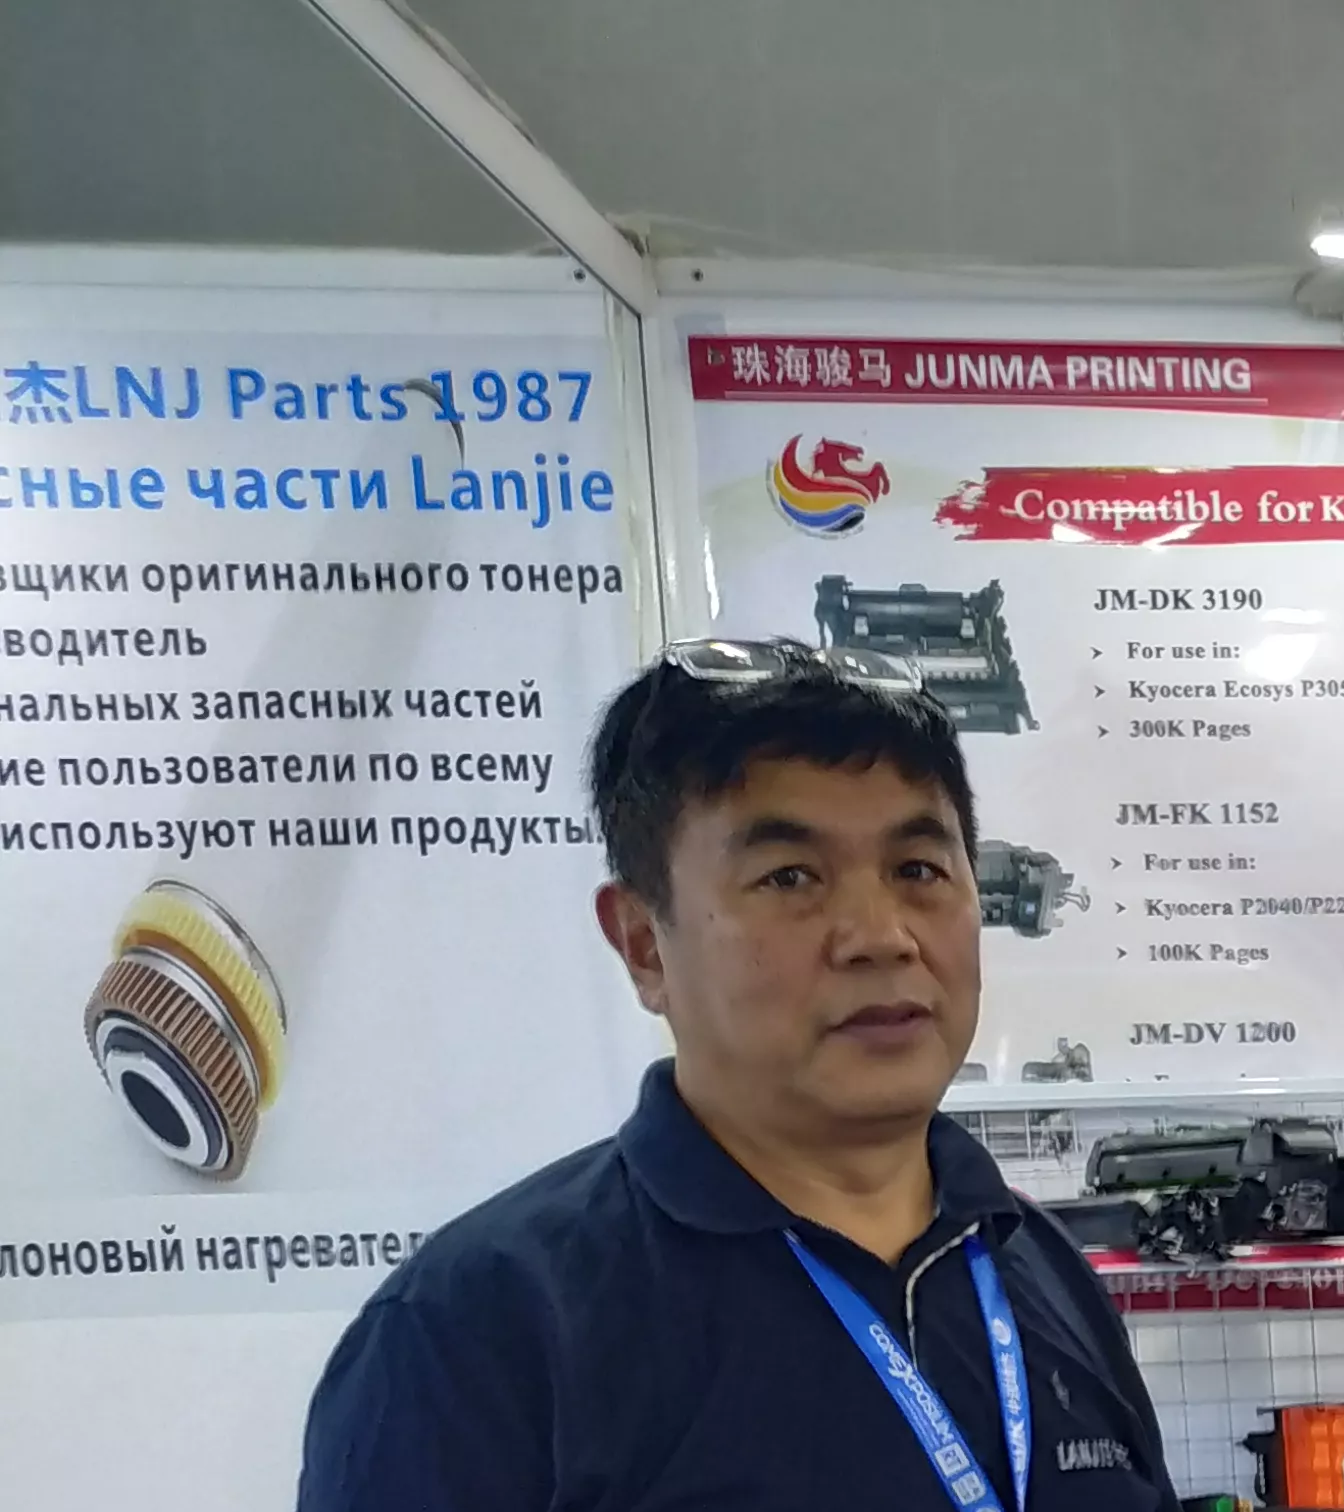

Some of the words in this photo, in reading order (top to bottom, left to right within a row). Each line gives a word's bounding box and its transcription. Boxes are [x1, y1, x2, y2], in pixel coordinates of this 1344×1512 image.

[732, 345, 891, 388] 珠海骏马
[905, 355, 1053, 391] JUNMA
[1067, 357, 1251, 392] PRINTING
[2, 361, 199, 424] 杰LNJ
[227, 369, 409, 422] Parts
[431, 370, 593, 422] 1987
[188, 467, 388, 511] части
[411, 454, 616, 530] Lanjie
[1012, 489, 1244, 531] Compatible
[1257, 492, 1314, 525] for
[142, 561, 470, 602] оригинального
[479, 561, 625, 604] тонера
[1094, 589, 1193, 611] JM-DK
[1202, 589, 1263, 610] 3190
[3, 627, 208, 667] водитель
[1127, 642, 1165, 660] For
[1172, 646, 1206, 660] use
[1212, 642, 1240, 660] in:
[192, 690, 393, 720] запасных
[405, 680, 543, 719] частей
[1129, 681, 1217, 702] Kyocera
[1224, 680, 1294, 701] Ecosys
[1129, 720, 1186, 738] 300K
[1193, 720, 1251, 741] Pages
[59, 752, 356, 786] пользователи
[369, 751, 419, 782] по
[430, 753, 554, 793] всему
[1116, 804, 1213, 825] JM-FK
[1220, 803, 1279, 825] 1152
[1, 818, 256, 860] используют
[269, 816, 378, 846] наши
[1144, 854, 1181, 871] For
[1188, 857, 1222, 871] use
[1228, 854, 1257, 870] in:
[1146, 898, 1234, 920] Kyocera
[1148, 944, 1203, 961] 100K
[1210, 944, 1269, 964] Pages
[1130, 1023, 1227, 1045] JM-DV
[1236, 1022, 1296, 1043] 1200
[0, 1224, 185, 1278] лоновый
